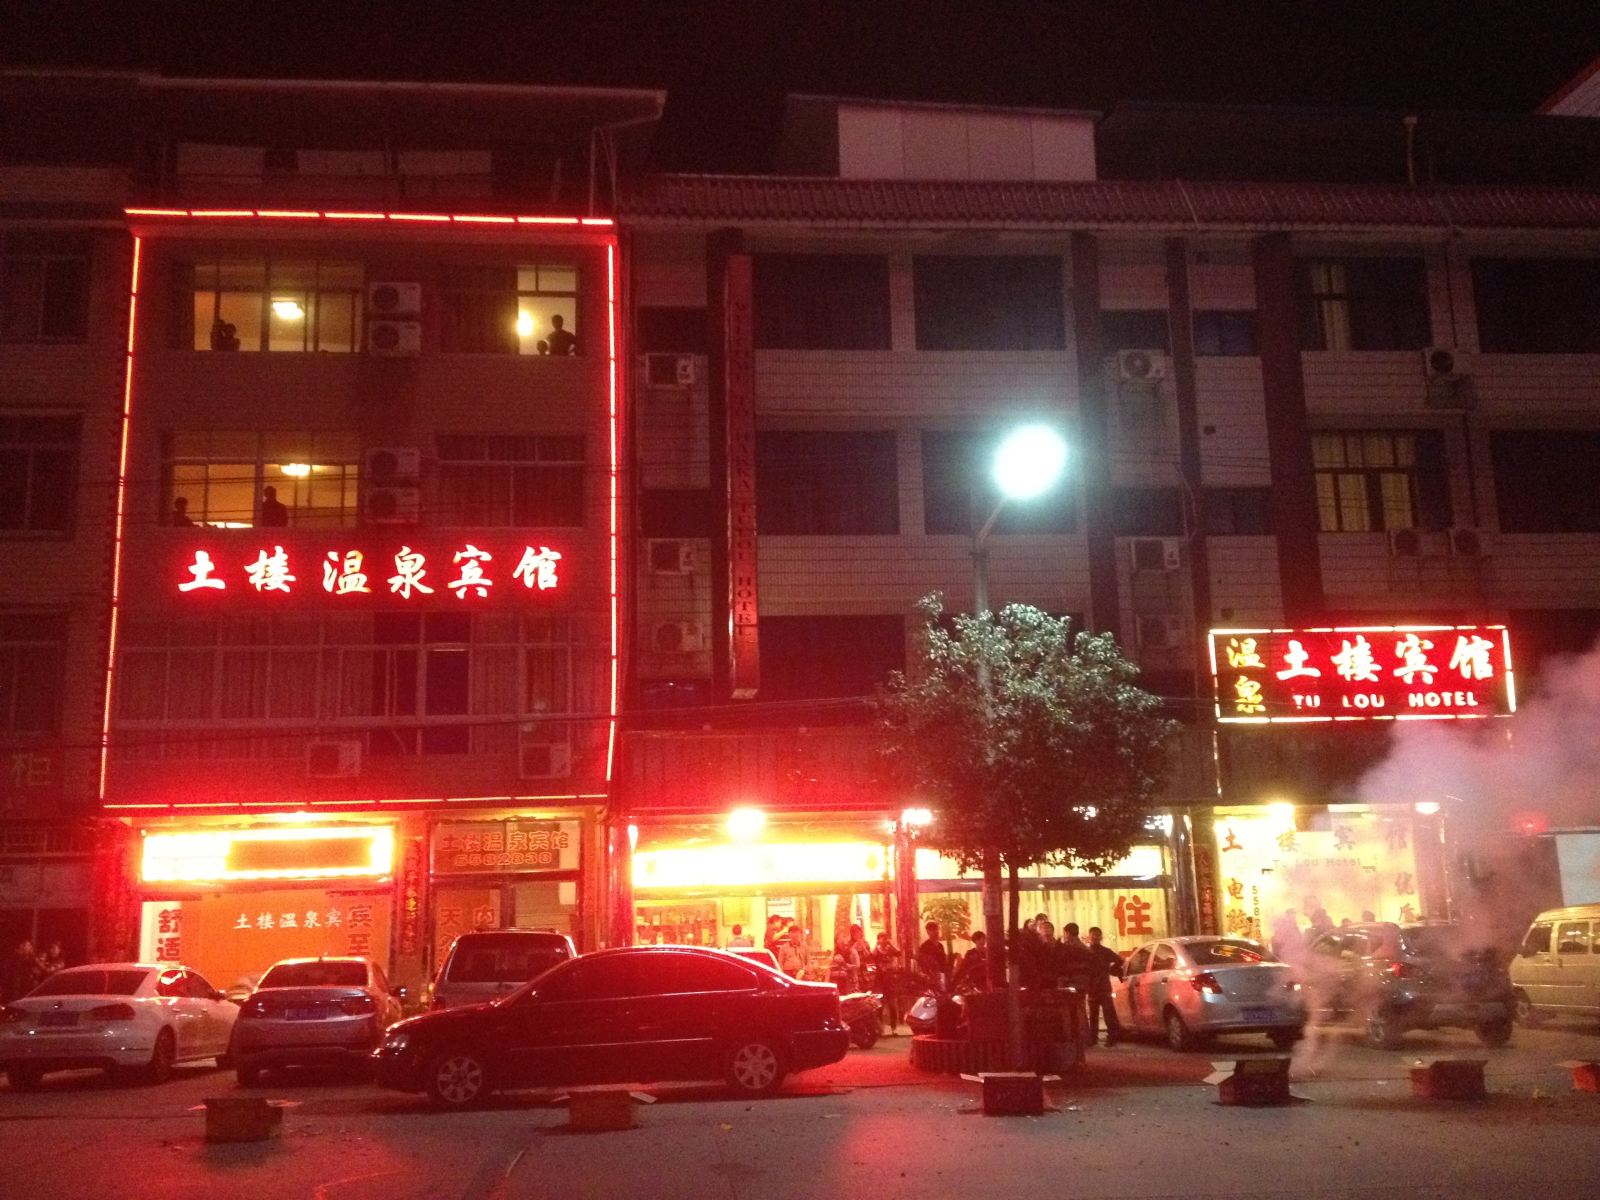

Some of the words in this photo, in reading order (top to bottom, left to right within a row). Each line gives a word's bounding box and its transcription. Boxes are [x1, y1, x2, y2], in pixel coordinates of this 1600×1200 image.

[735, 431, 751, 489] HAKKA
[178, 544, 562, 600] 土楼温泉宾馆
[737, 575, 753, 637] HOTEL
[1226, 637, 1267, 714] 温泉
[1276, 633, 1495, 685] 土楼宾馆
[1292, 694, 1321, 709] TU
[1342, 693, 1385, 708] LOU
[1408, 691, 1478, 707] HOTEL
[441, 830, 569, 852] 土楼温泉宾馆
[156, 908, 183, 962] 舒适
[1114, 894, 1154, 937] 住
